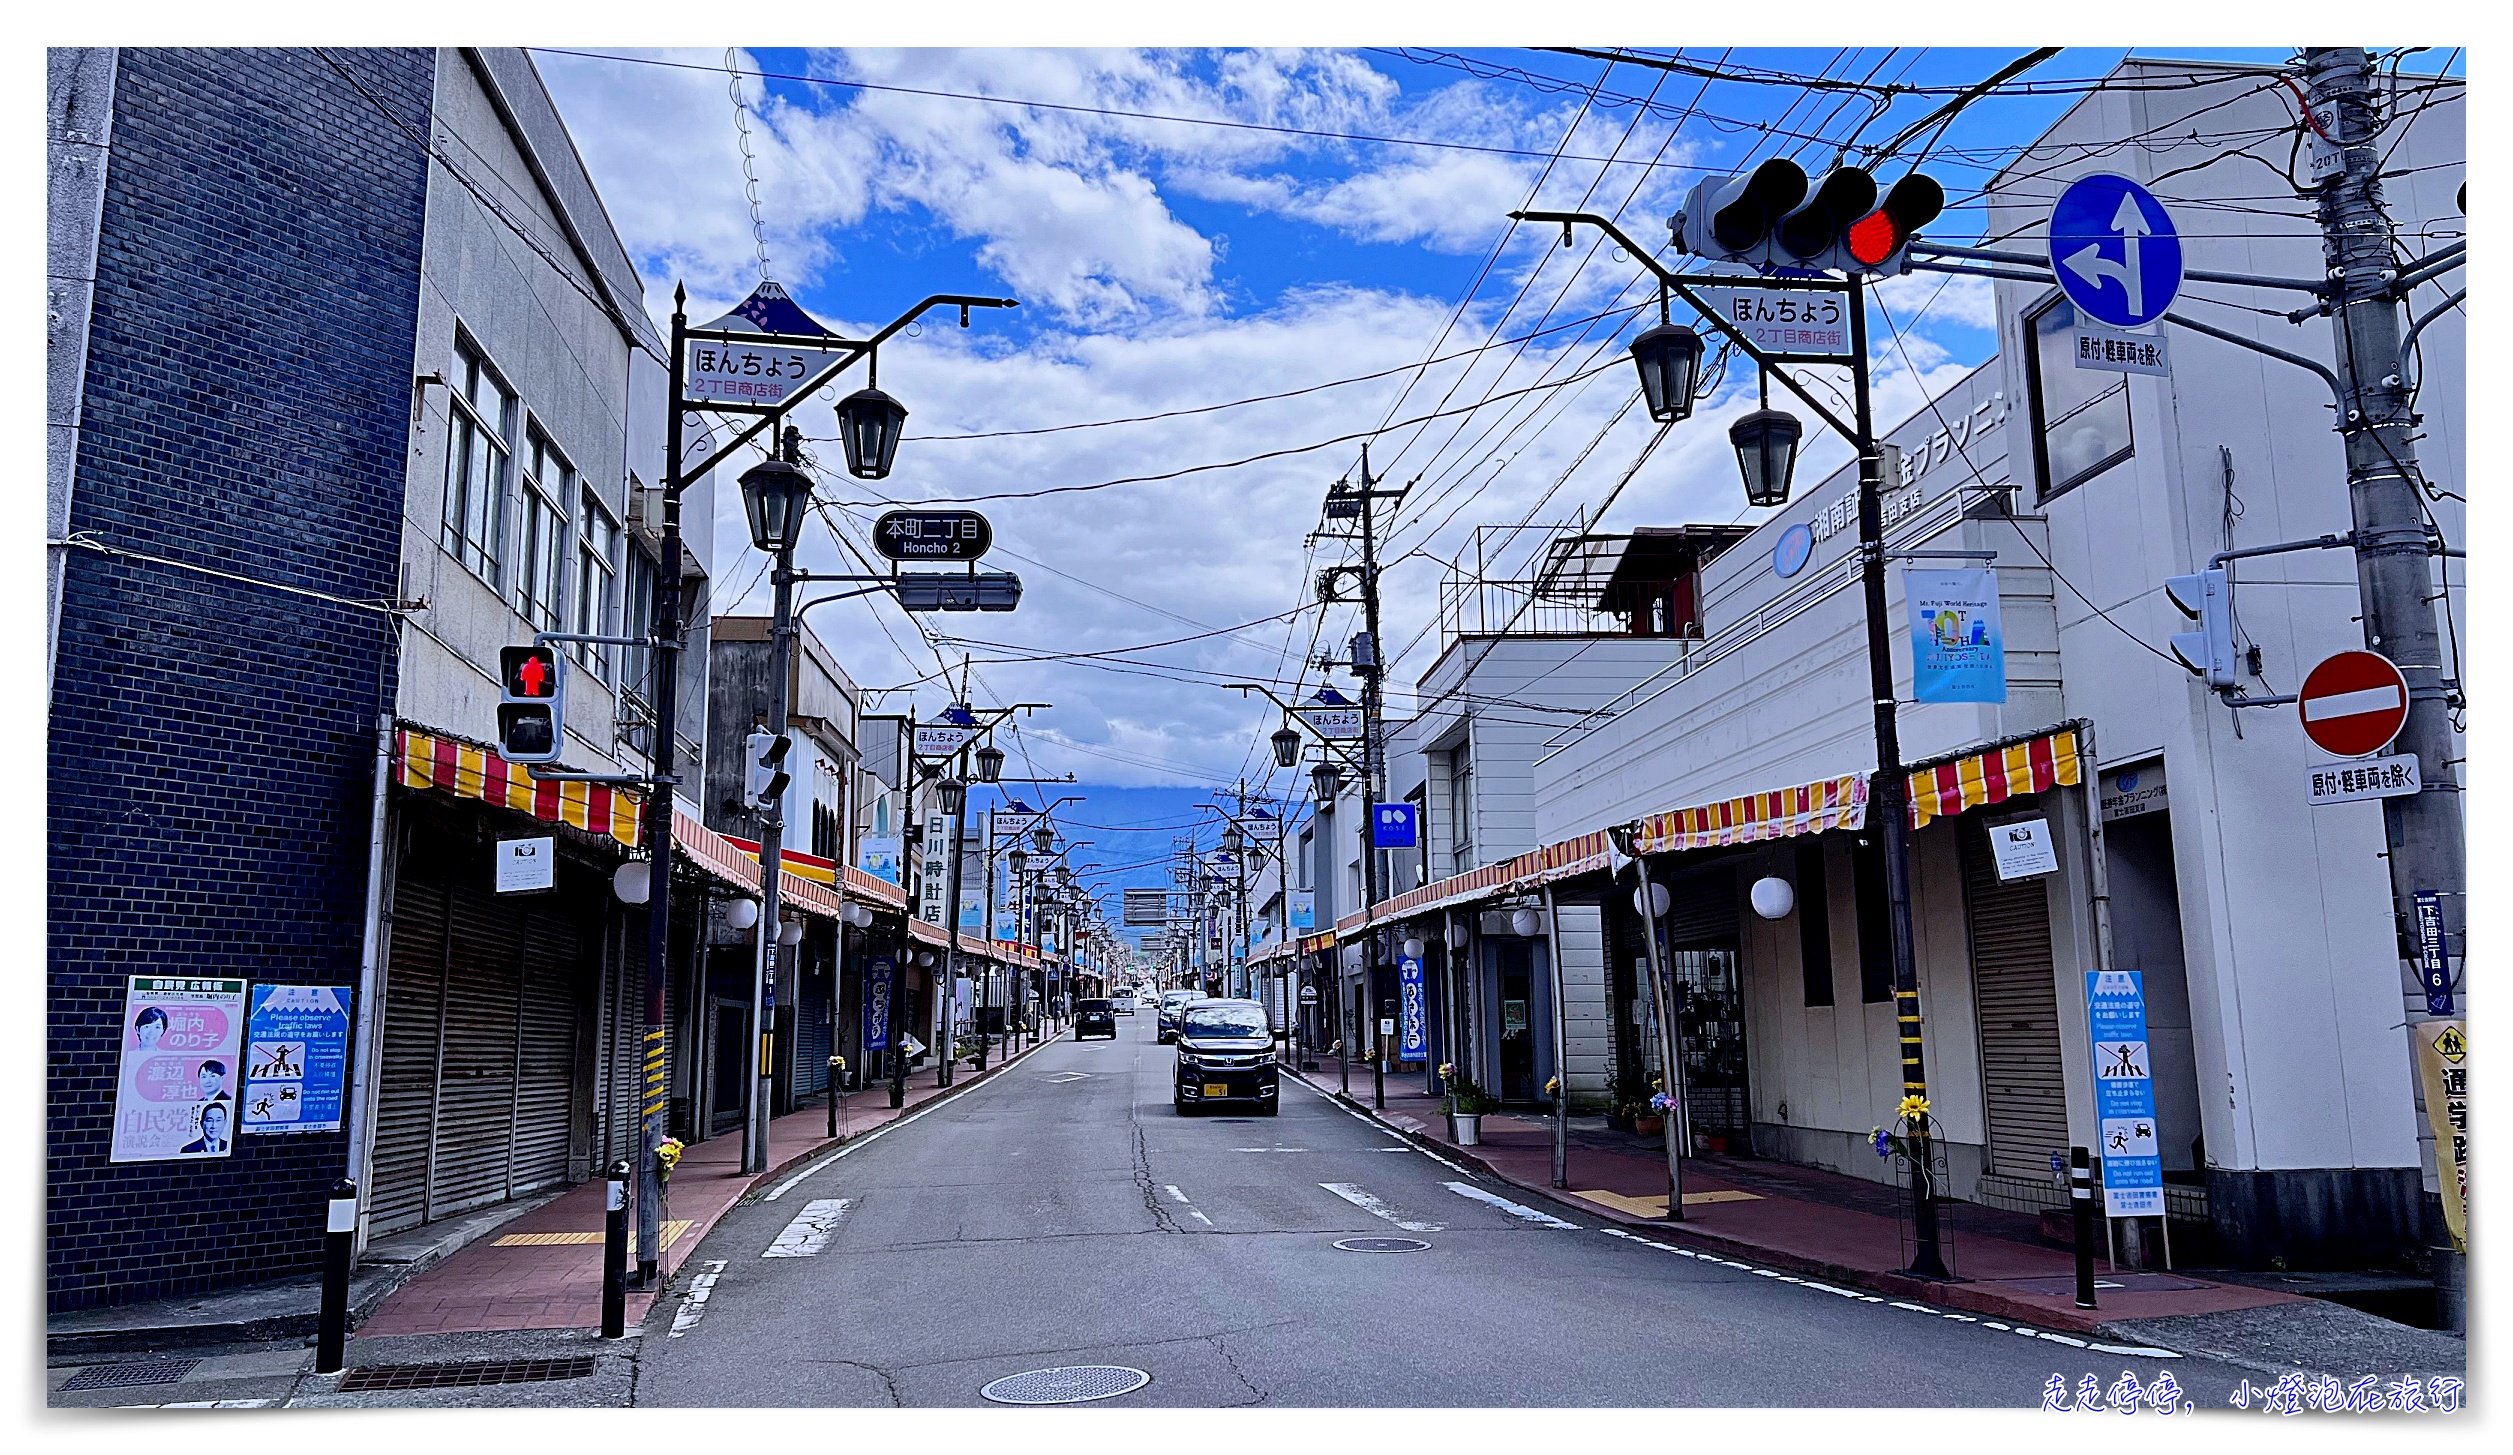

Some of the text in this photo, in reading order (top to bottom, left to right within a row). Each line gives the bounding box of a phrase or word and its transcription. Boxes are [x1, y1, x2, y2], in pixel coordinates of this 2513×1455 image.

[1733, 297, 1840, 324] ほんちょう
[1756, 328, 1841, 346] 2丁目商店街
[2080, 336, 2162, 368] 原付・軽車両を除く
[696, 349, 806, 380] ほんちょう
[695, 379, 783, 398] 2丁目商店街
[886, 518, 977, 539] 本町二丁目
[904, 542, 960, 553] Honcho 2
[1313, 714, 1358, 726] ほんちょう
[918, 732, 964, 742] ほんちょう
[2312, 764, 2414, 796] 原付・軽車両を除く
[924, 817, 944, 922] 日川時計店
[2422, 906, 2442, 986] 下吉田三丁目 6
[168, 1016, 204, 1032] 堀内
[278, 1022, 322, 1030] traffic laws
[169, 1033, 219, 1048] のり子
[124, 1108, 189, 1134] 自民党
